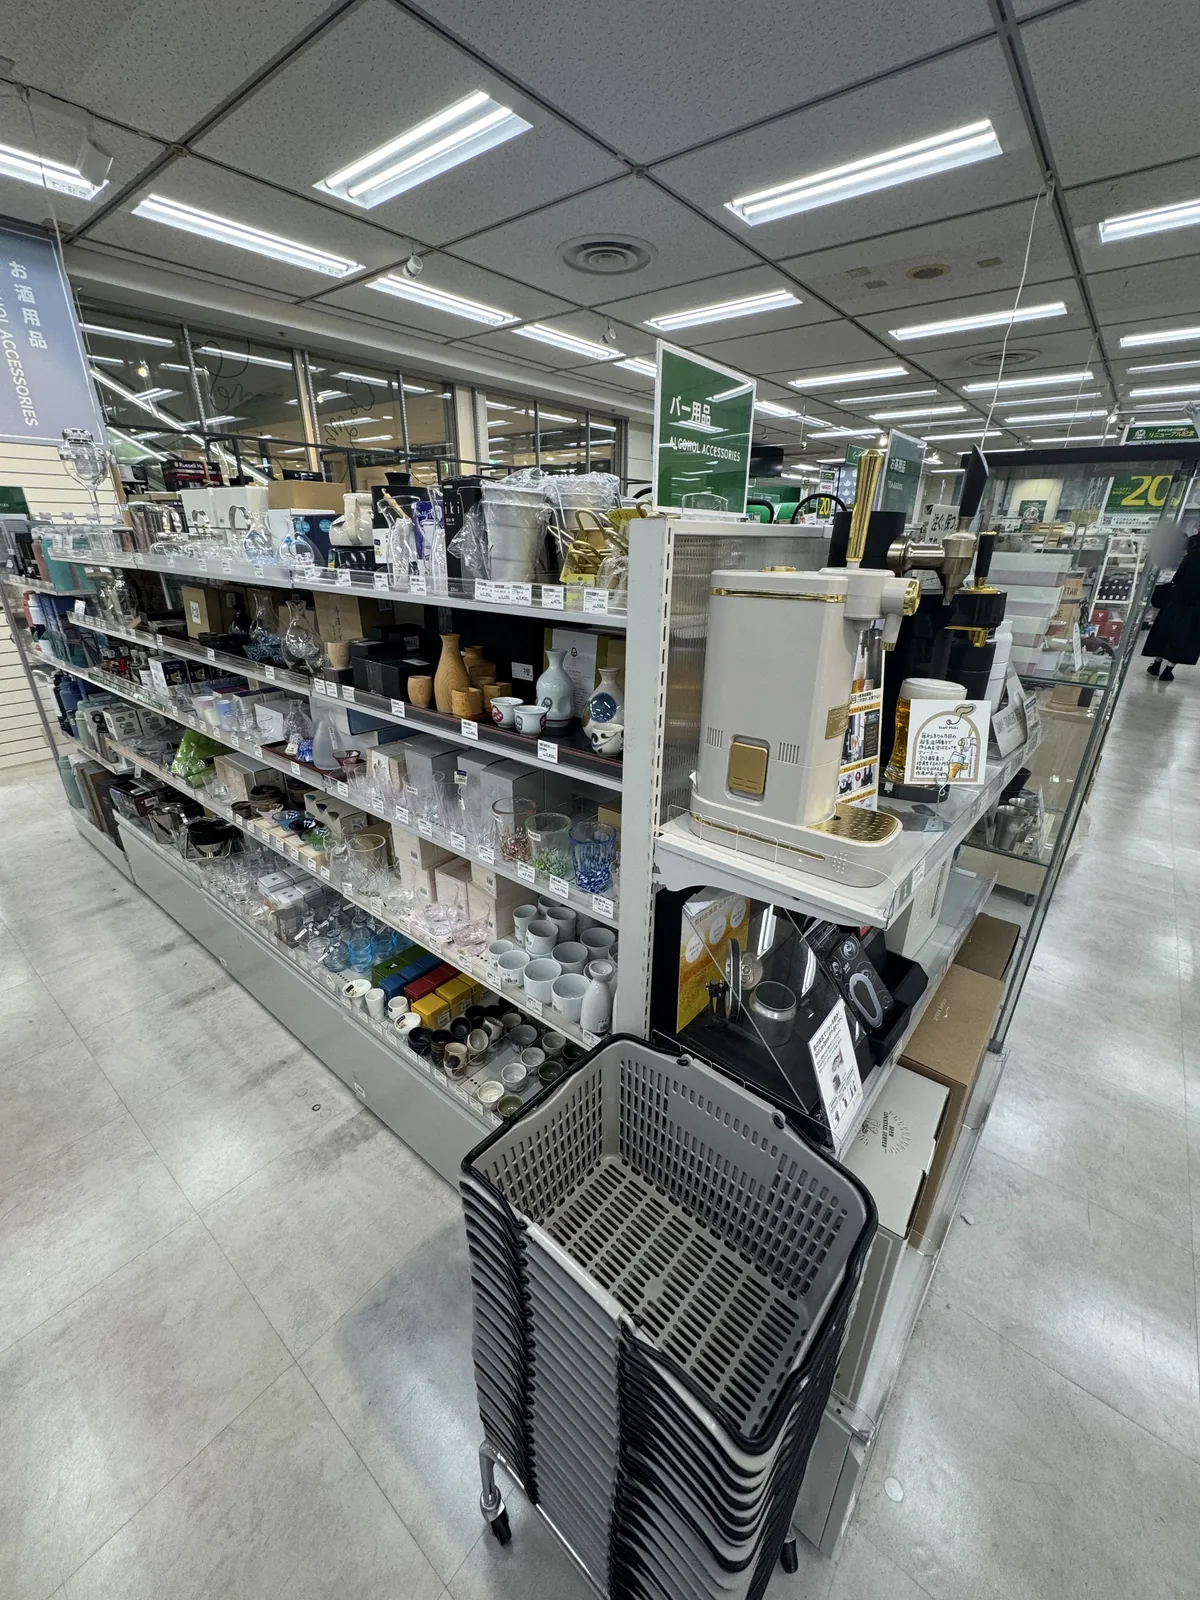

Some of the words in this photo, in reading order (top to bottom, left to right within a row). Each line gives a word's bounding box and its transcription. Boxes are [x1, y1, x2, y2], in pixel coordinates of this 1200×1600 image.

[8, 260, 48, 350] お酒用品
[0, 328, 39, 427] ACCESSORIES
[669, 435, 701, 454] ALCOHOL
[701, 444, 741, 462] ACCESSORIES
[1121, 474, 1178, 507] 20
[444, 501, 460, 515] iki
[819, 497, 831, 515] 20
